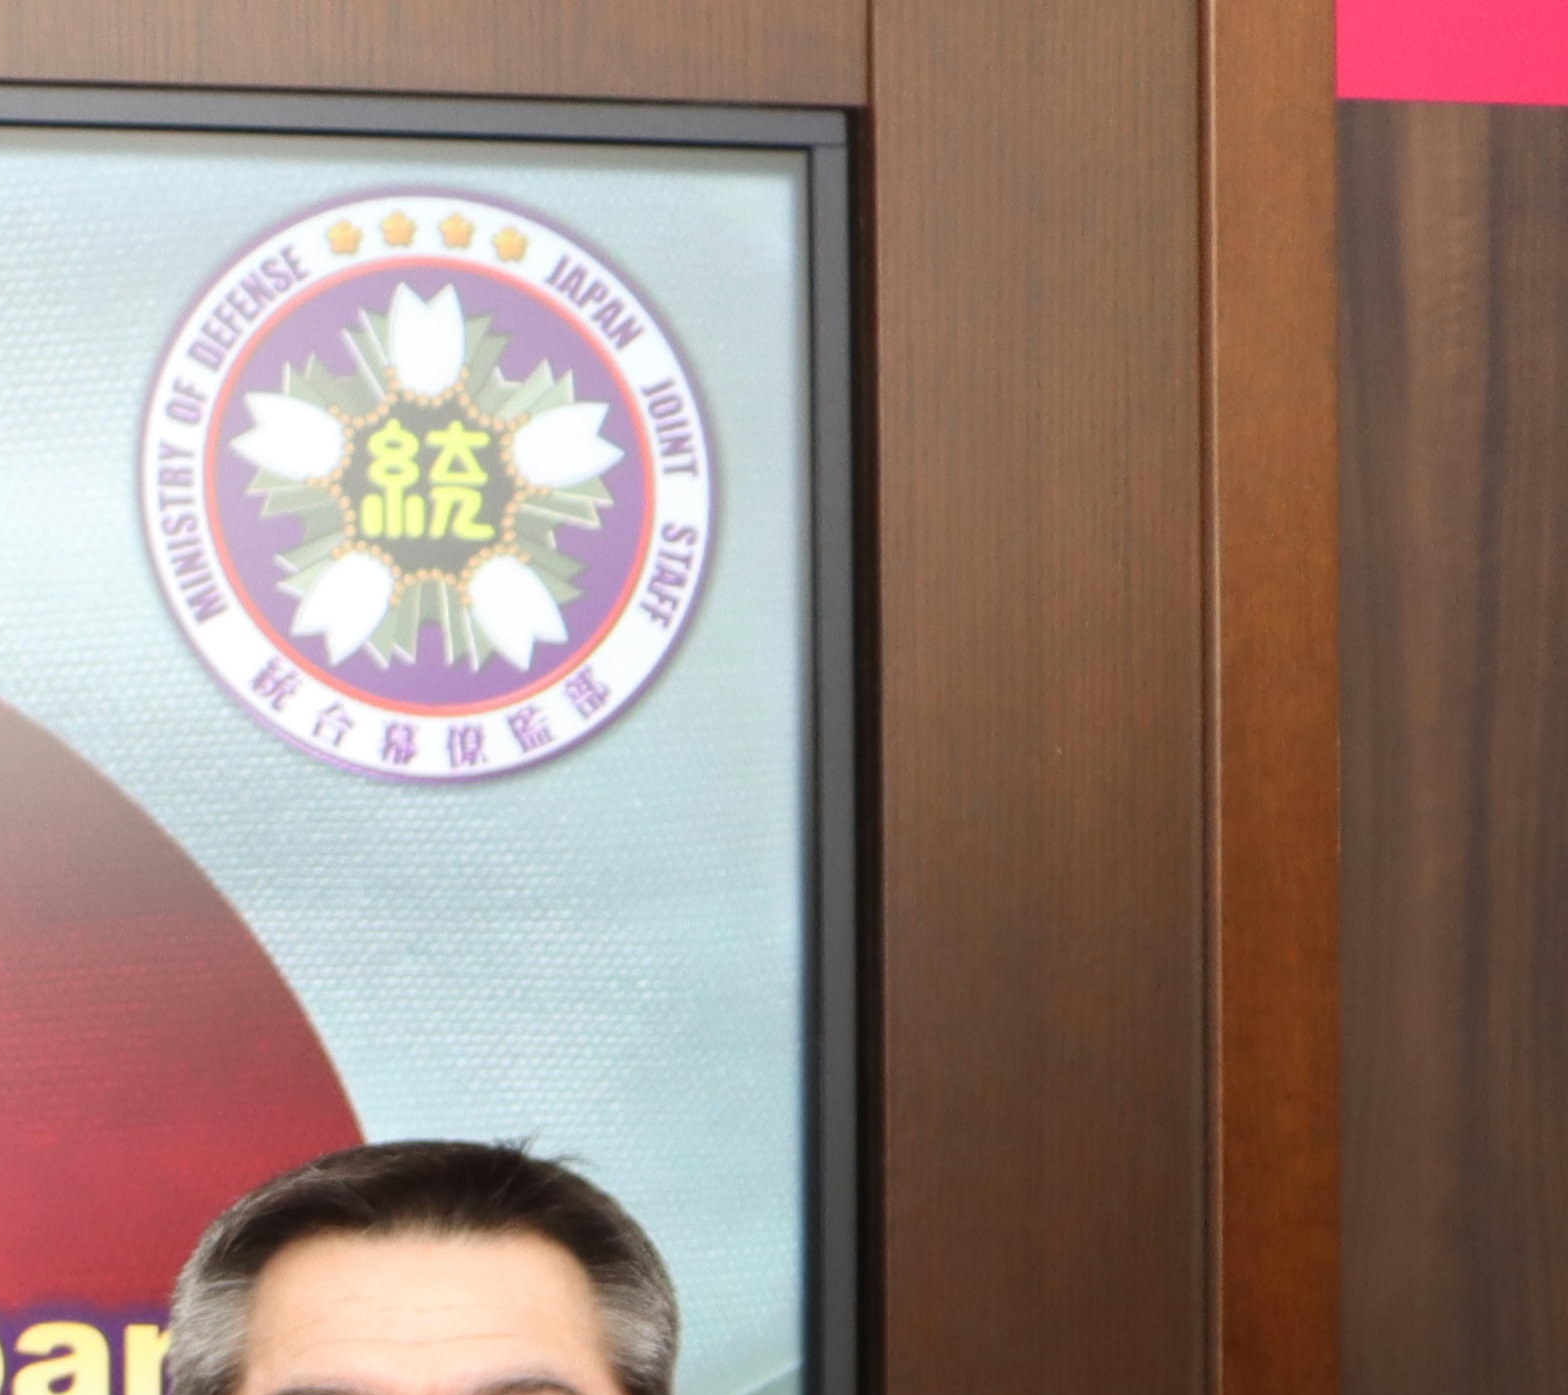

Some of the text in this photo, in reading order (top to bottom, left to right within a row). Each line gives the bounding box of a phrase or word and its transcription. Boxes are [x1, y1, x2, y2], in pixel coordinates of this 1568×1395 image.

[158, 244, 311, 624] MINISTRY OF DEFENSE
[545, 253, 700, 629] JAPAN JOINT STAFF
